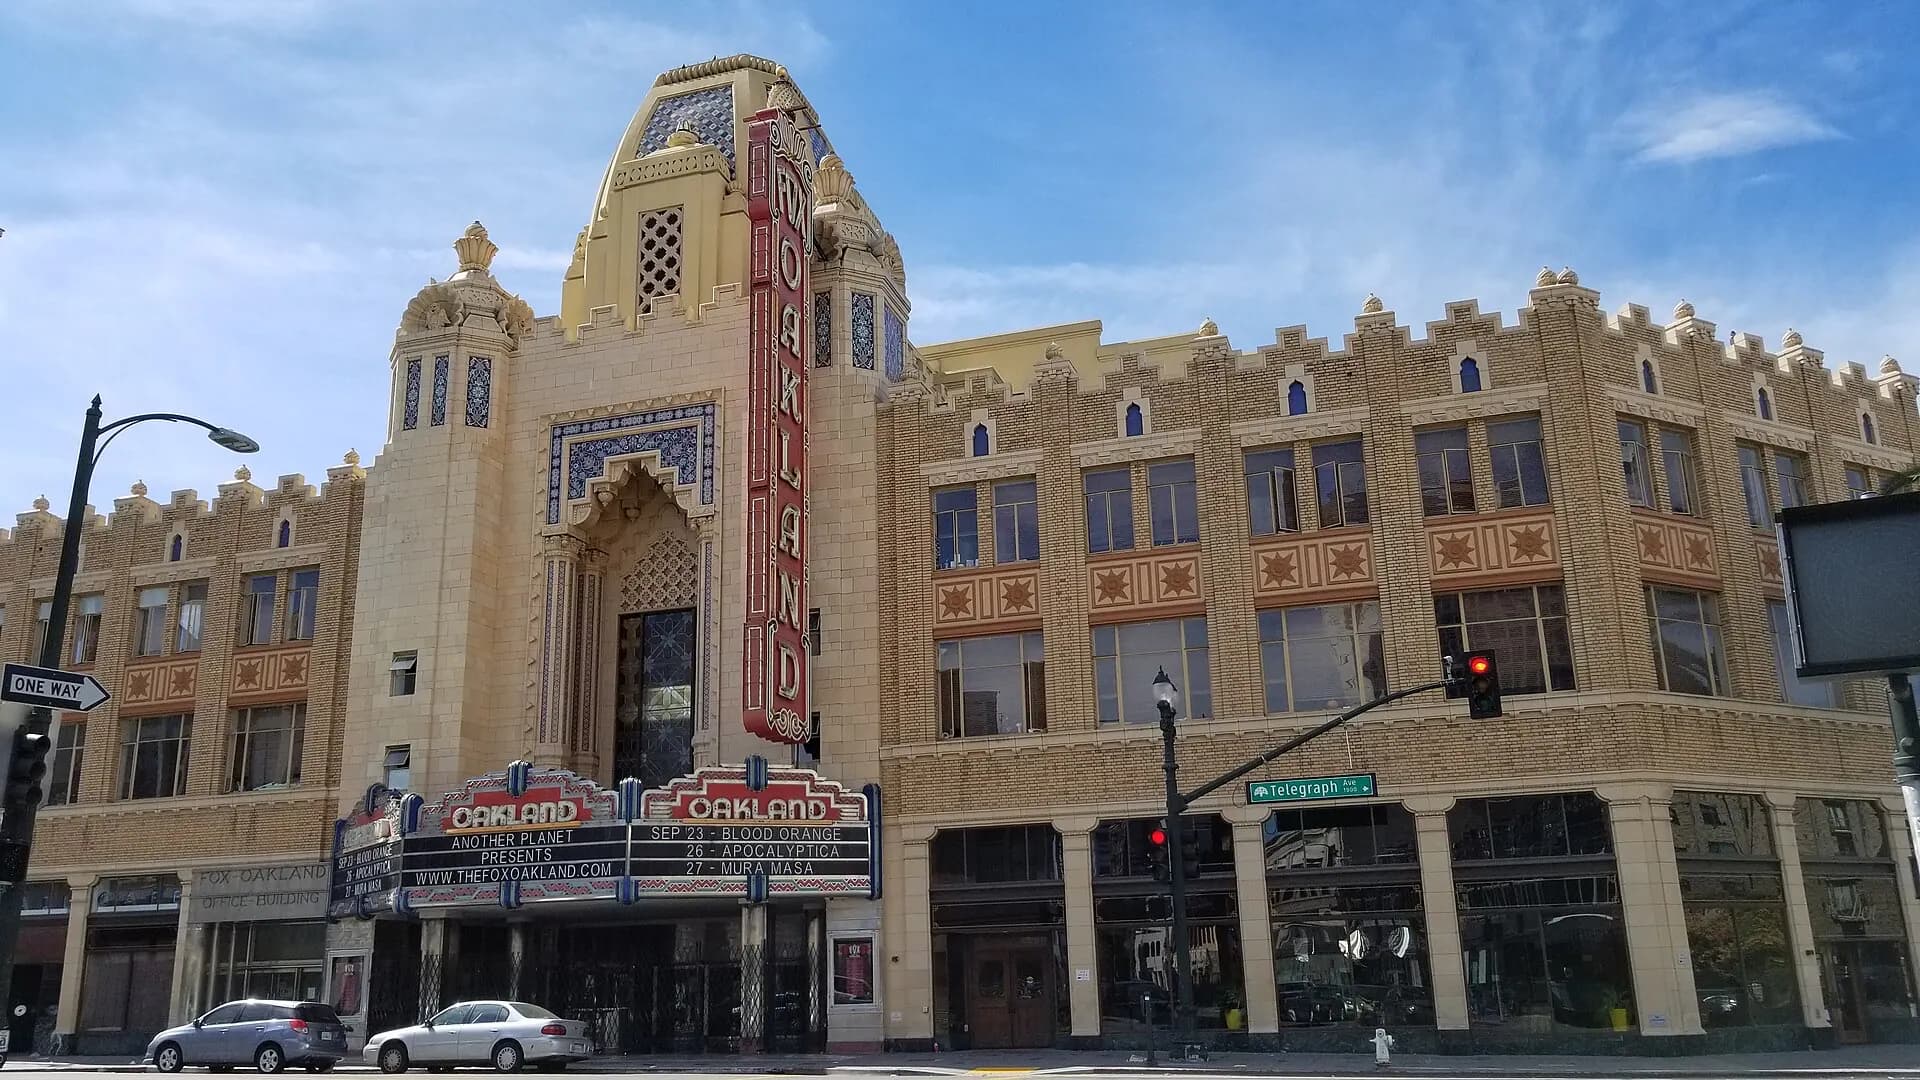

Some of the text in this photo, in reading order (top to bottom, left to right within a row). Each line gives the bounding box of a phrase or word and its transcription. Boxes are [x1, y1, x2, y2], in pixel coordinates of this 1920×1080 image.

[777, 163, 808, 240] FOX
[778, 237, 803, 701] OAKLAND
[15, 677, 81, 699] ONE WAY
[1270, 778, 1357, 797] Telegraph Ave
[451, 800, 578, 828] OAKLAND
[688, 798, 826, 820] OAKLAND
[451, 829, 574, 849] ANOTHER PLANET
[651, 826, 680, 840] SEP
[722, 826, 773, 841] BLOOD
[779, 826, 841, 841] ORANGE
[481, 848, 552, 865] PRESENTS
[686, 844, 703, 858] 26
[722, 843, 840, 858] APOCALYPTICA
[338, 857, 347, 869] SEP
[686, 861, 703, 875] 27
[721, 861, 764, 875] MURA
[771, 861, 813, 875] MASA
[201, 865, 327, 884] FOX OAKLAND
[416, 862, 612, 885] WWW.THEFOXOAKLAND.COM
[202, 892, 319, 909] OFFICE BUILDING
